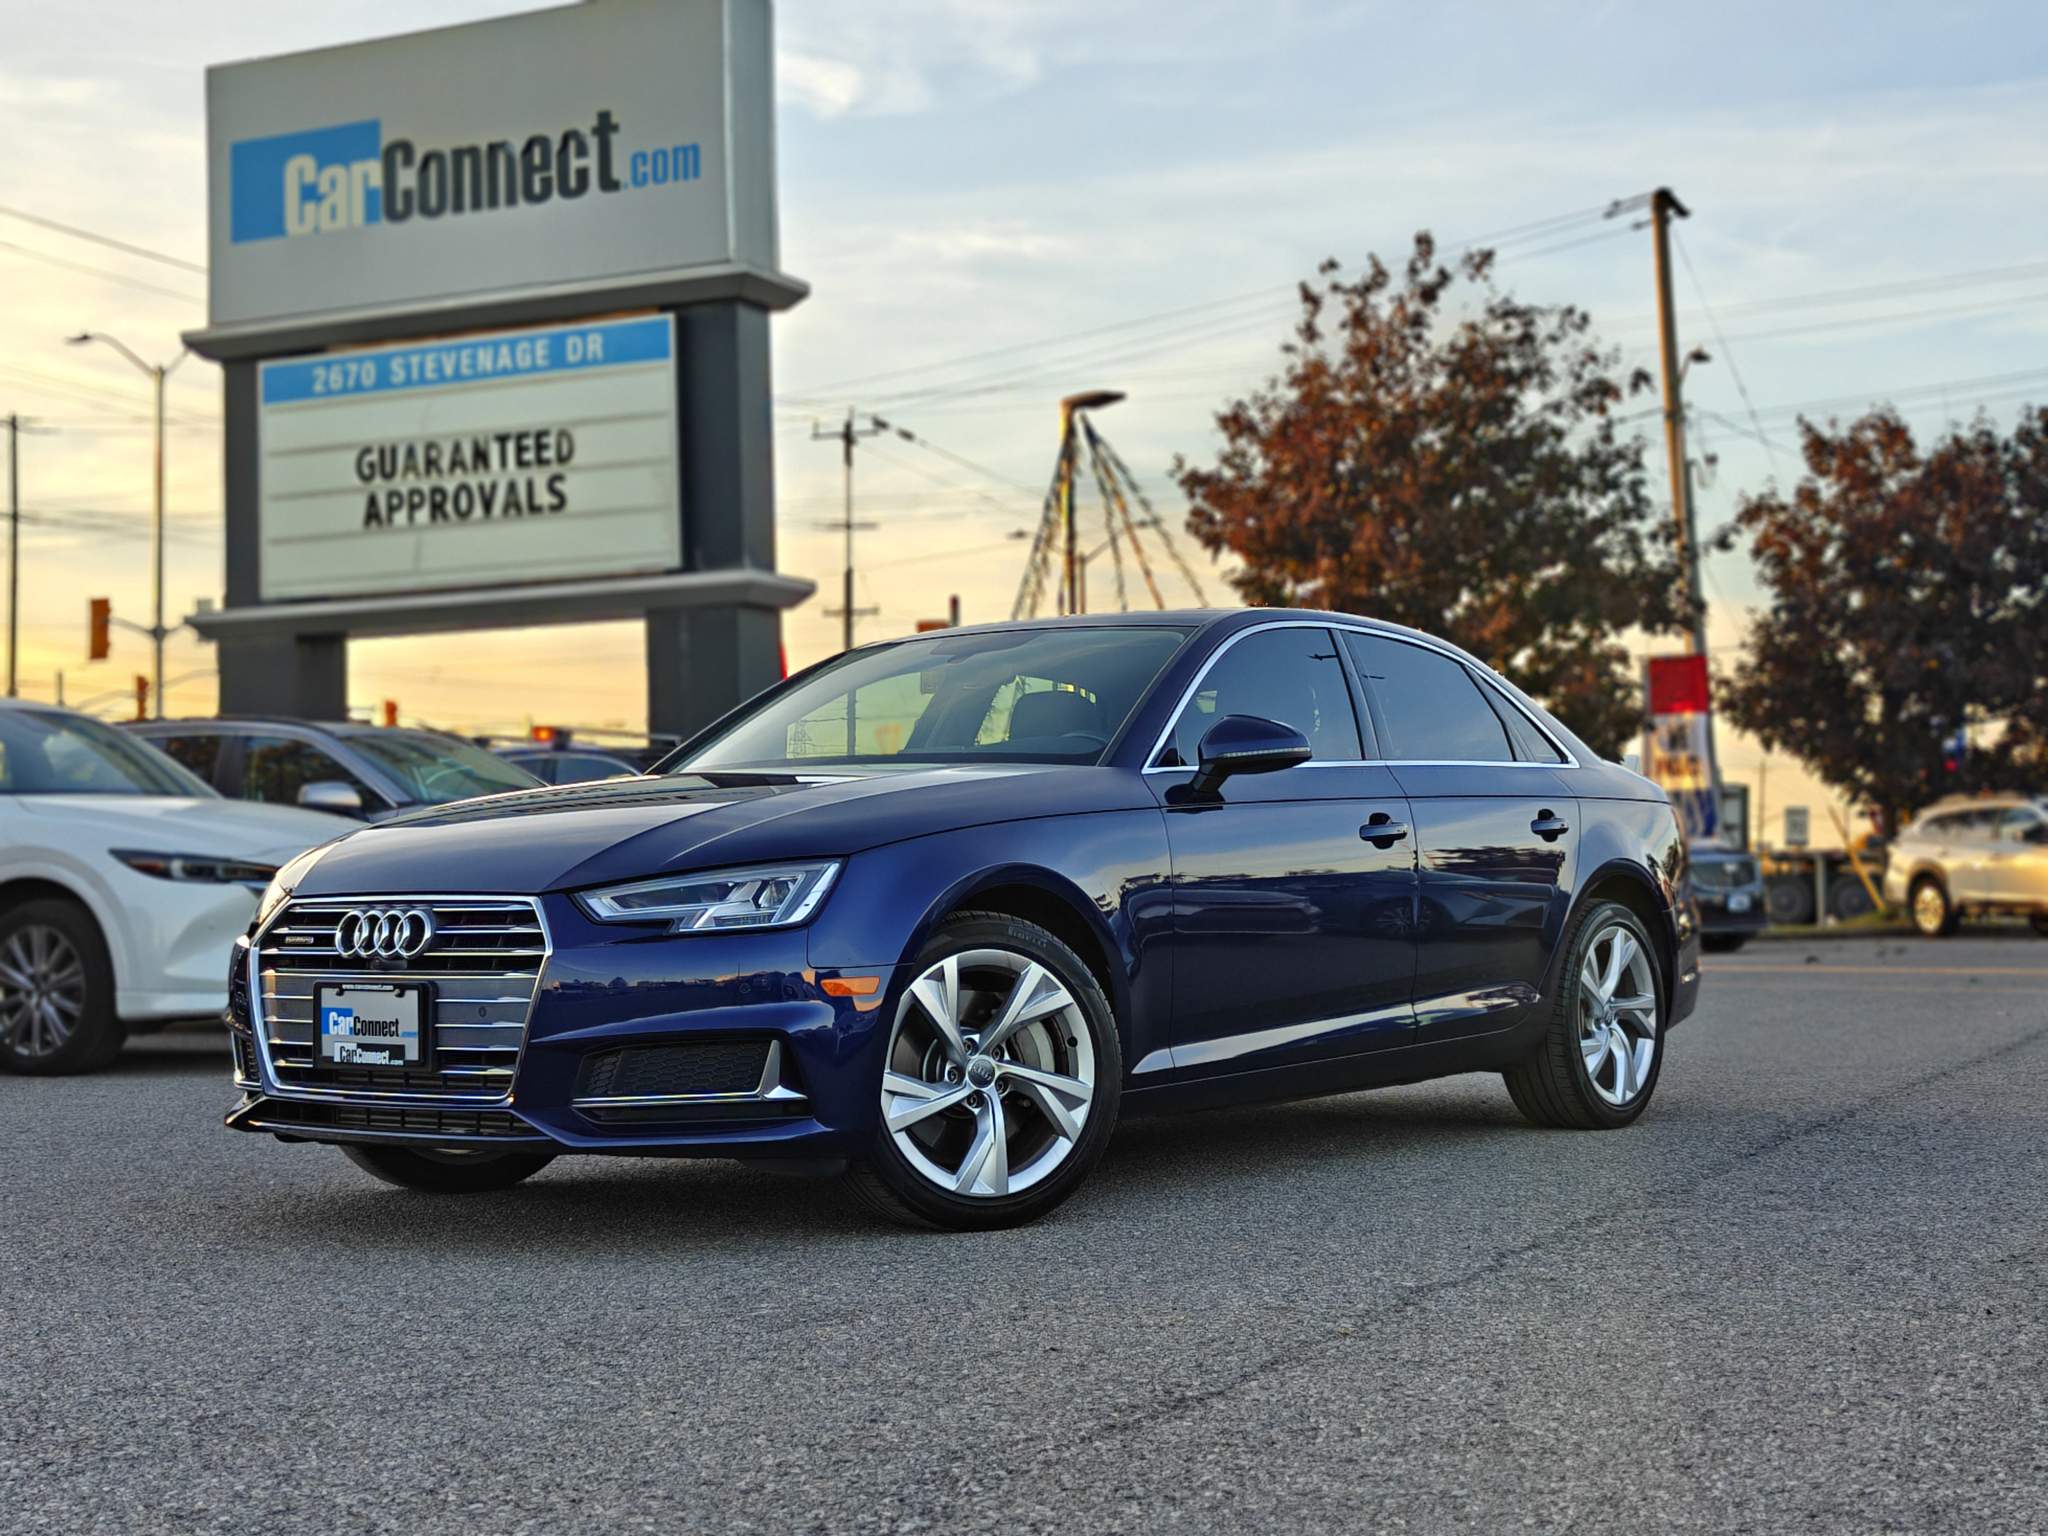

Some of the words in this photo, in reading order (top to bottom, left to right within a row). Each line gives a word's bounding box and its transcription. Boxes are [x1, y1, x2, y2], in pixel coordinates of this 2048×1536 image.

[284, 110, 702, 236] CarConnect.com
[312, 361, 377, 393] 2670
[390, 338, 549, 385] STEVENAGE
[565, 333, 604, 363] DR
[355, 428, 575, 482] GUARANTEED
[363, 473, 567, 528] APPROVALS
